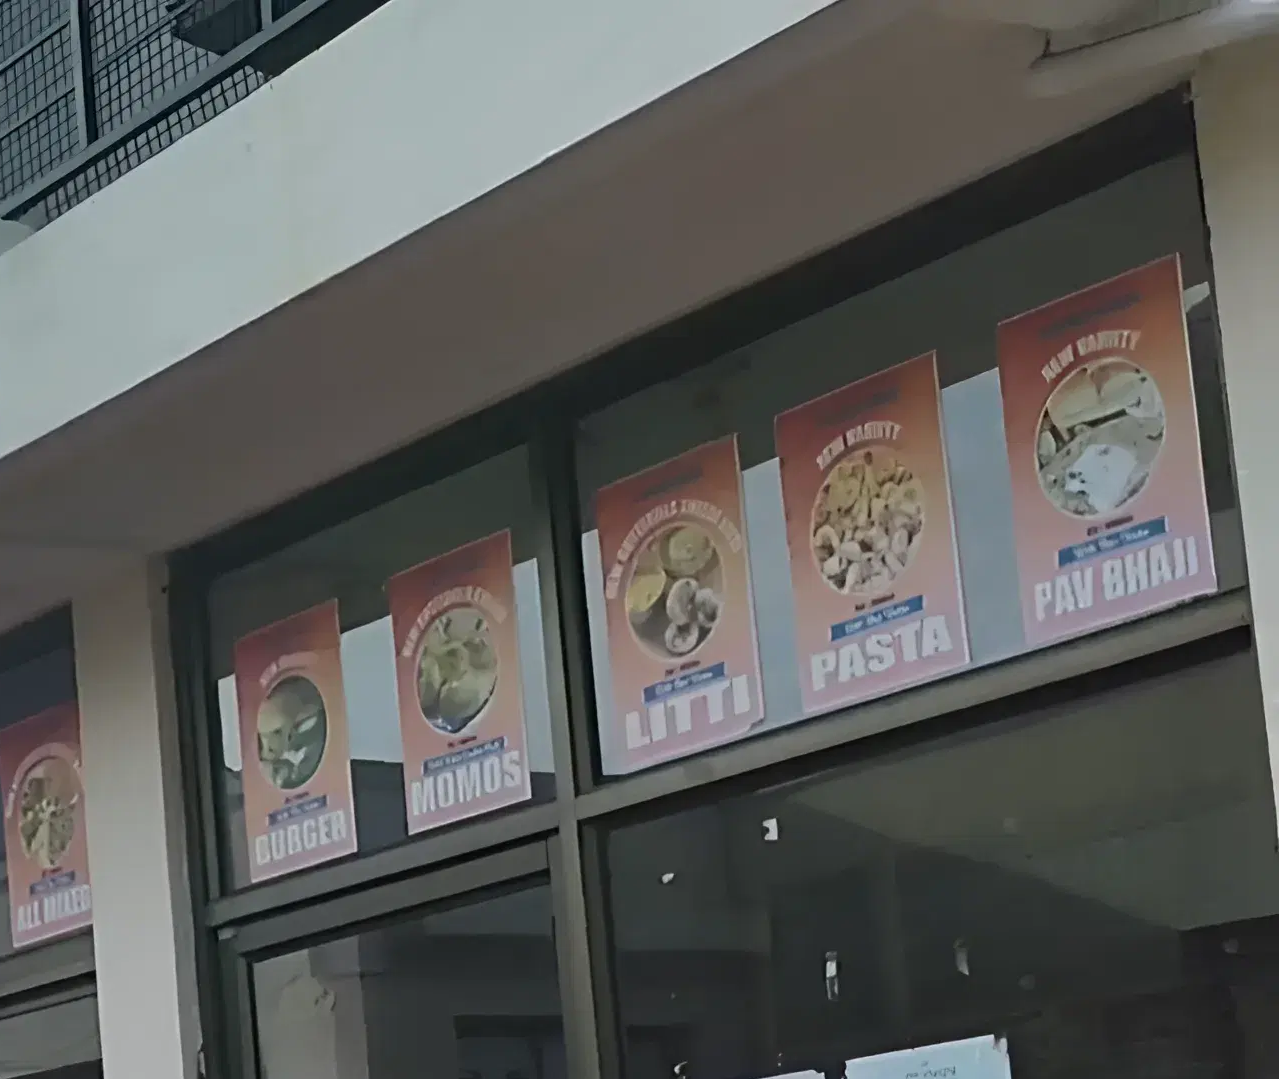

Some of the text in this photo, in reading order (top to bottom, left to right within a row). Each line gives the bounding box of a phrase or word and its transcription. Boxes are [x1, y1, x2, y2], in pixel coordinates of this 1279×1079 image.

[1034, 566, 1094, 621] PAV
[1102, 535, 1199, 601] BHAJI
[810, 615, 953, 691] PASTA
[625, 674, 750, 750] LITTI
[409, 750, 521, 816] MOMOS
[255, 810, 347, 865] BURGER
